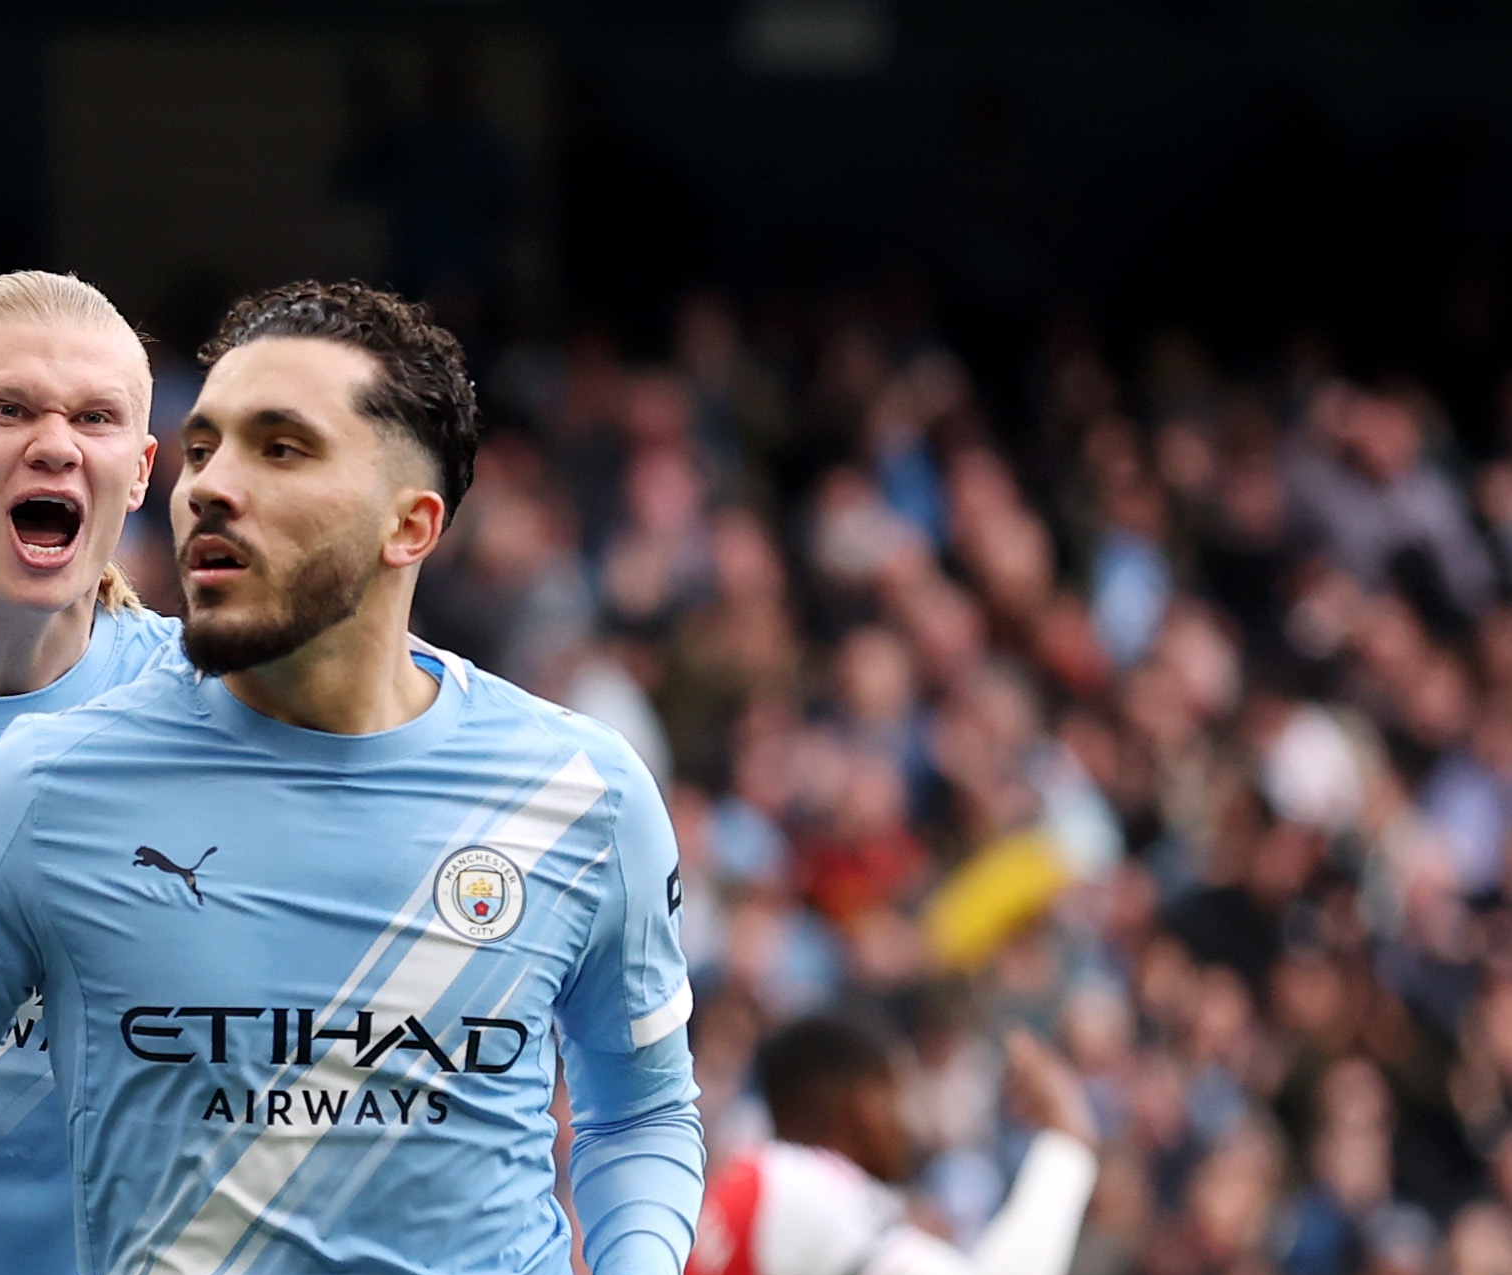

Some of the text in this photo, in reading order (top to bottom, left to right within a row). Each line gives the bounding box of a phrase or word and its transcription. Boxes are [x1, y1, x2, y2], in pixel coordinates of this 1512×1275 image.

[444, 853, 517, 884] MANCHESTER
[469, 926, 495, 936] CITY
[119, 1005, 529, 1075] ETIHAD
[202, 1087, 453, 1125] AIRWAYS
